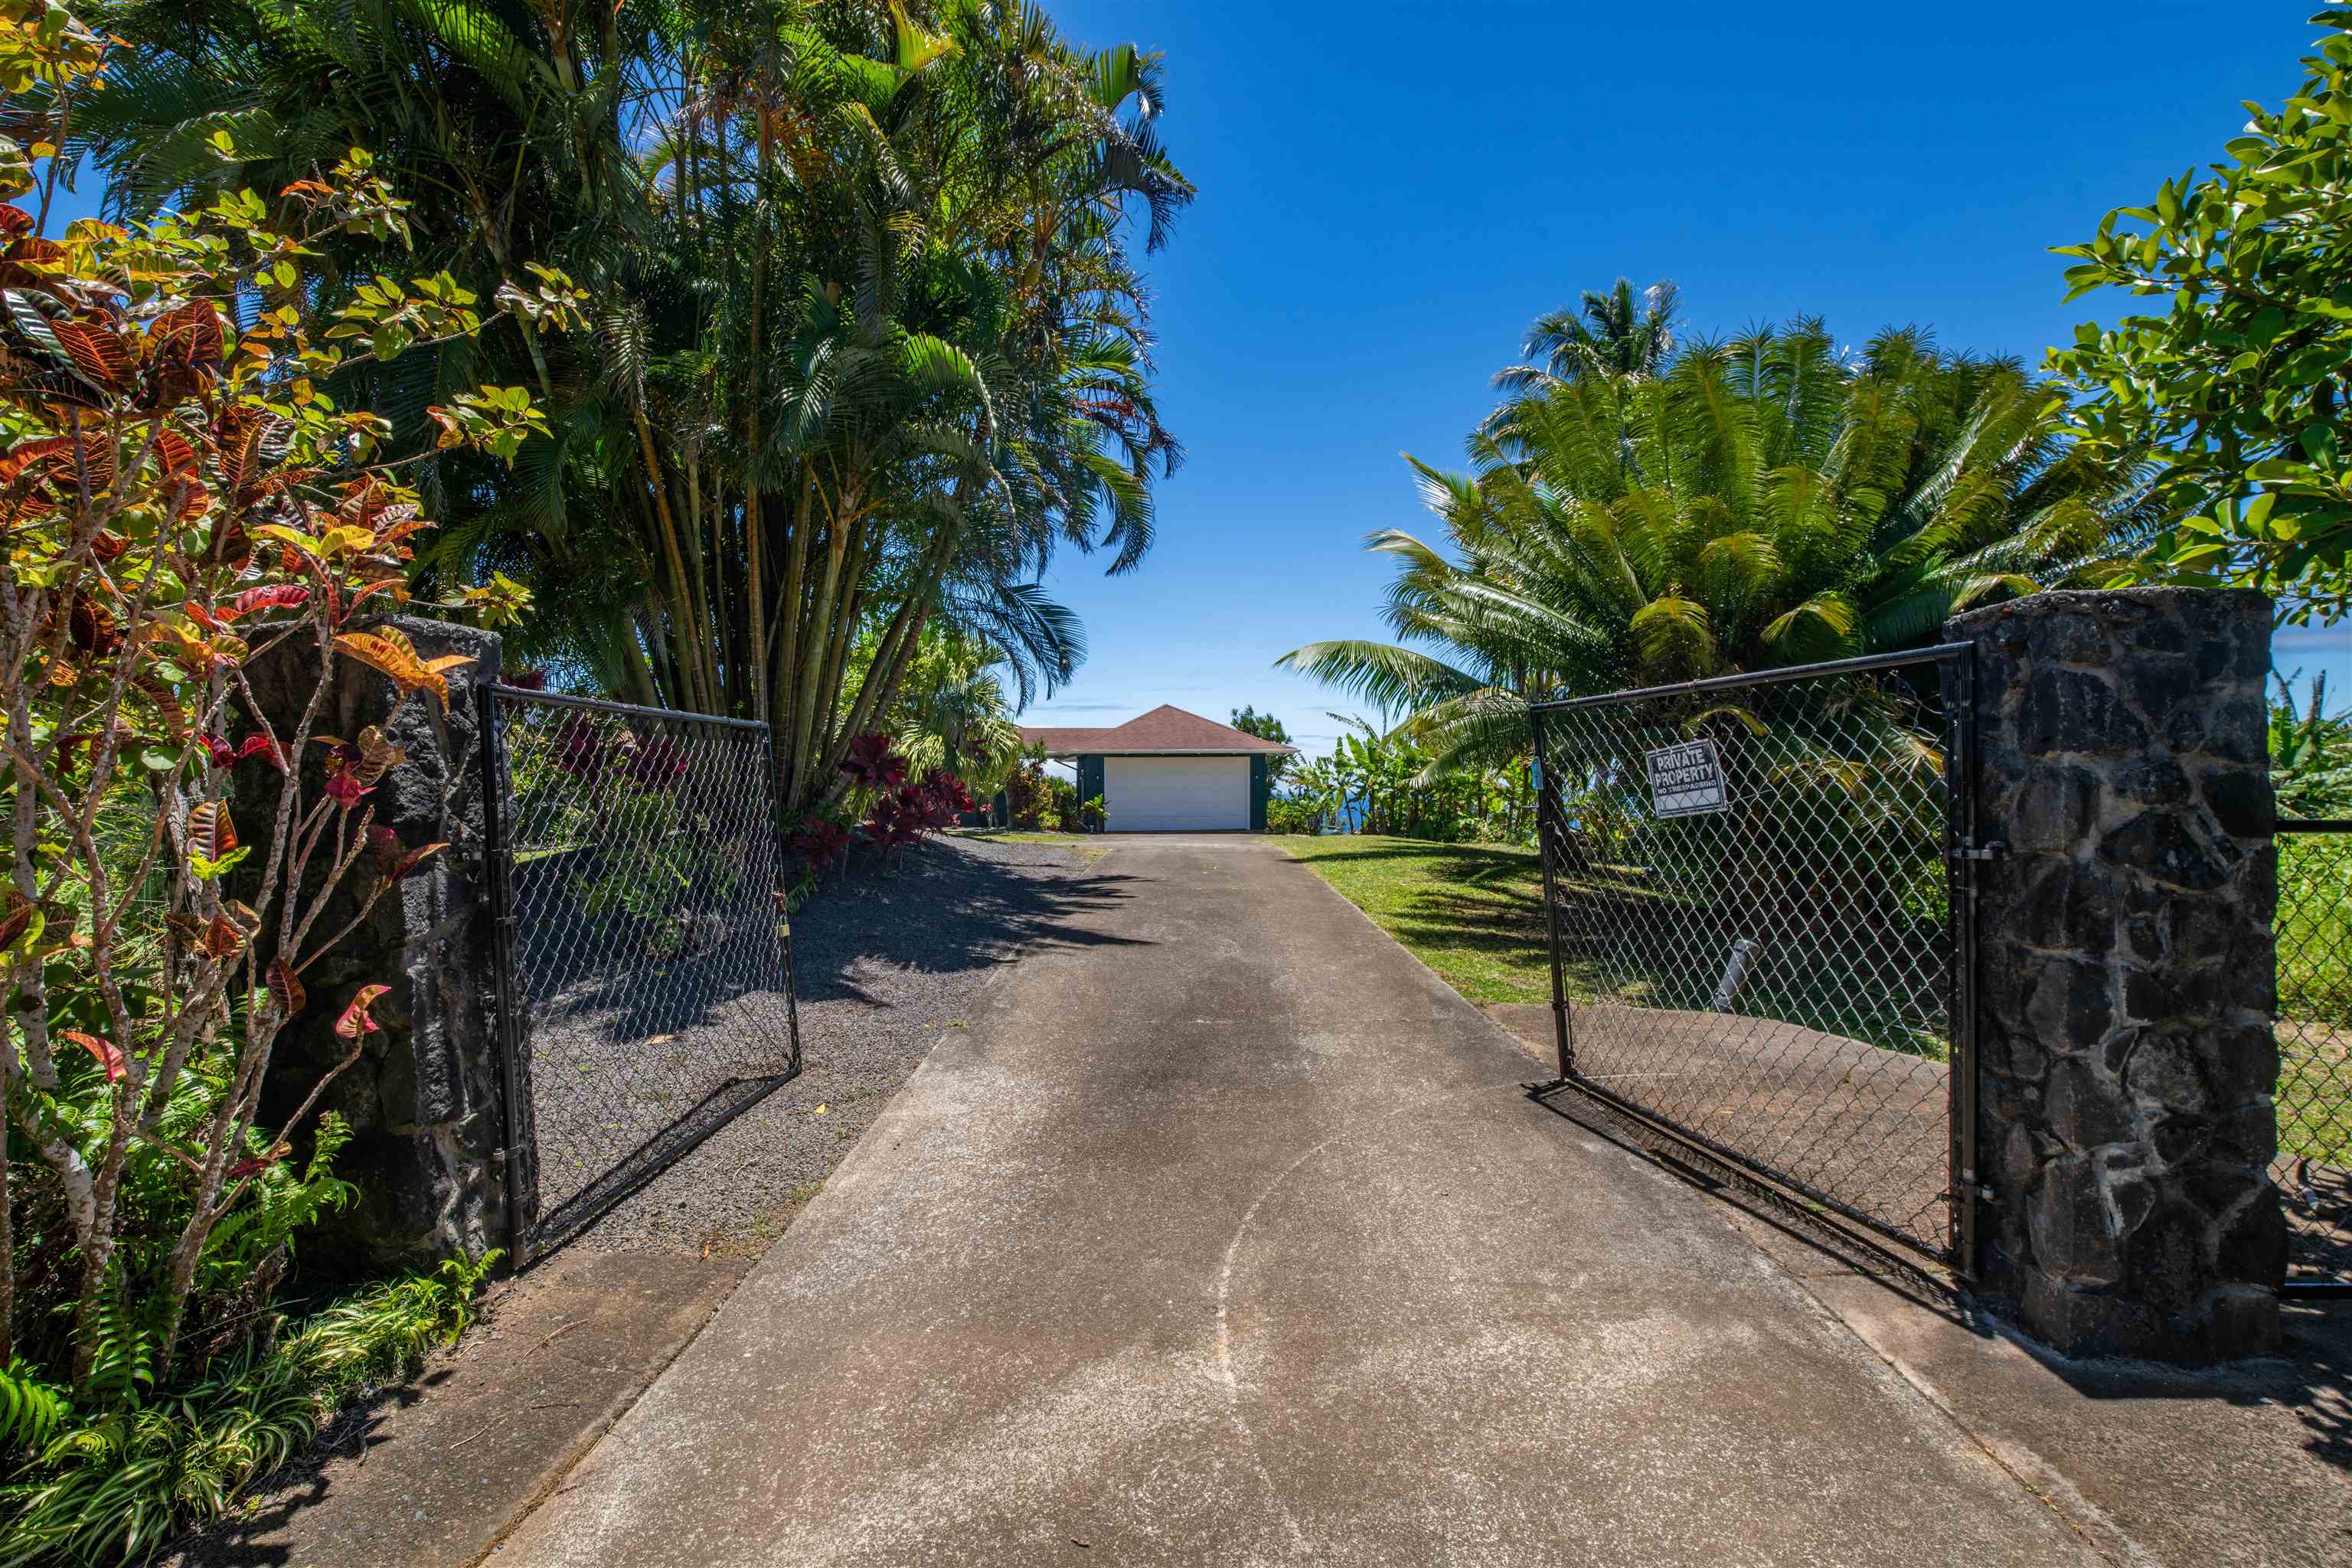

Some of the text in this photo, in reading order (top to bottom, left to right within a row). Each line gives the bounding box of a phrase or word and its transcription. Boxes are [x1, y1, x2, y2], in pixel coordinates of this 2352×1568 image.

[1657, 749, 1705, 771] PRIVATE
[1655, 763, 1712, 786] PROPERTY
[1668, 780, 1717, 793] TRESPASSING
